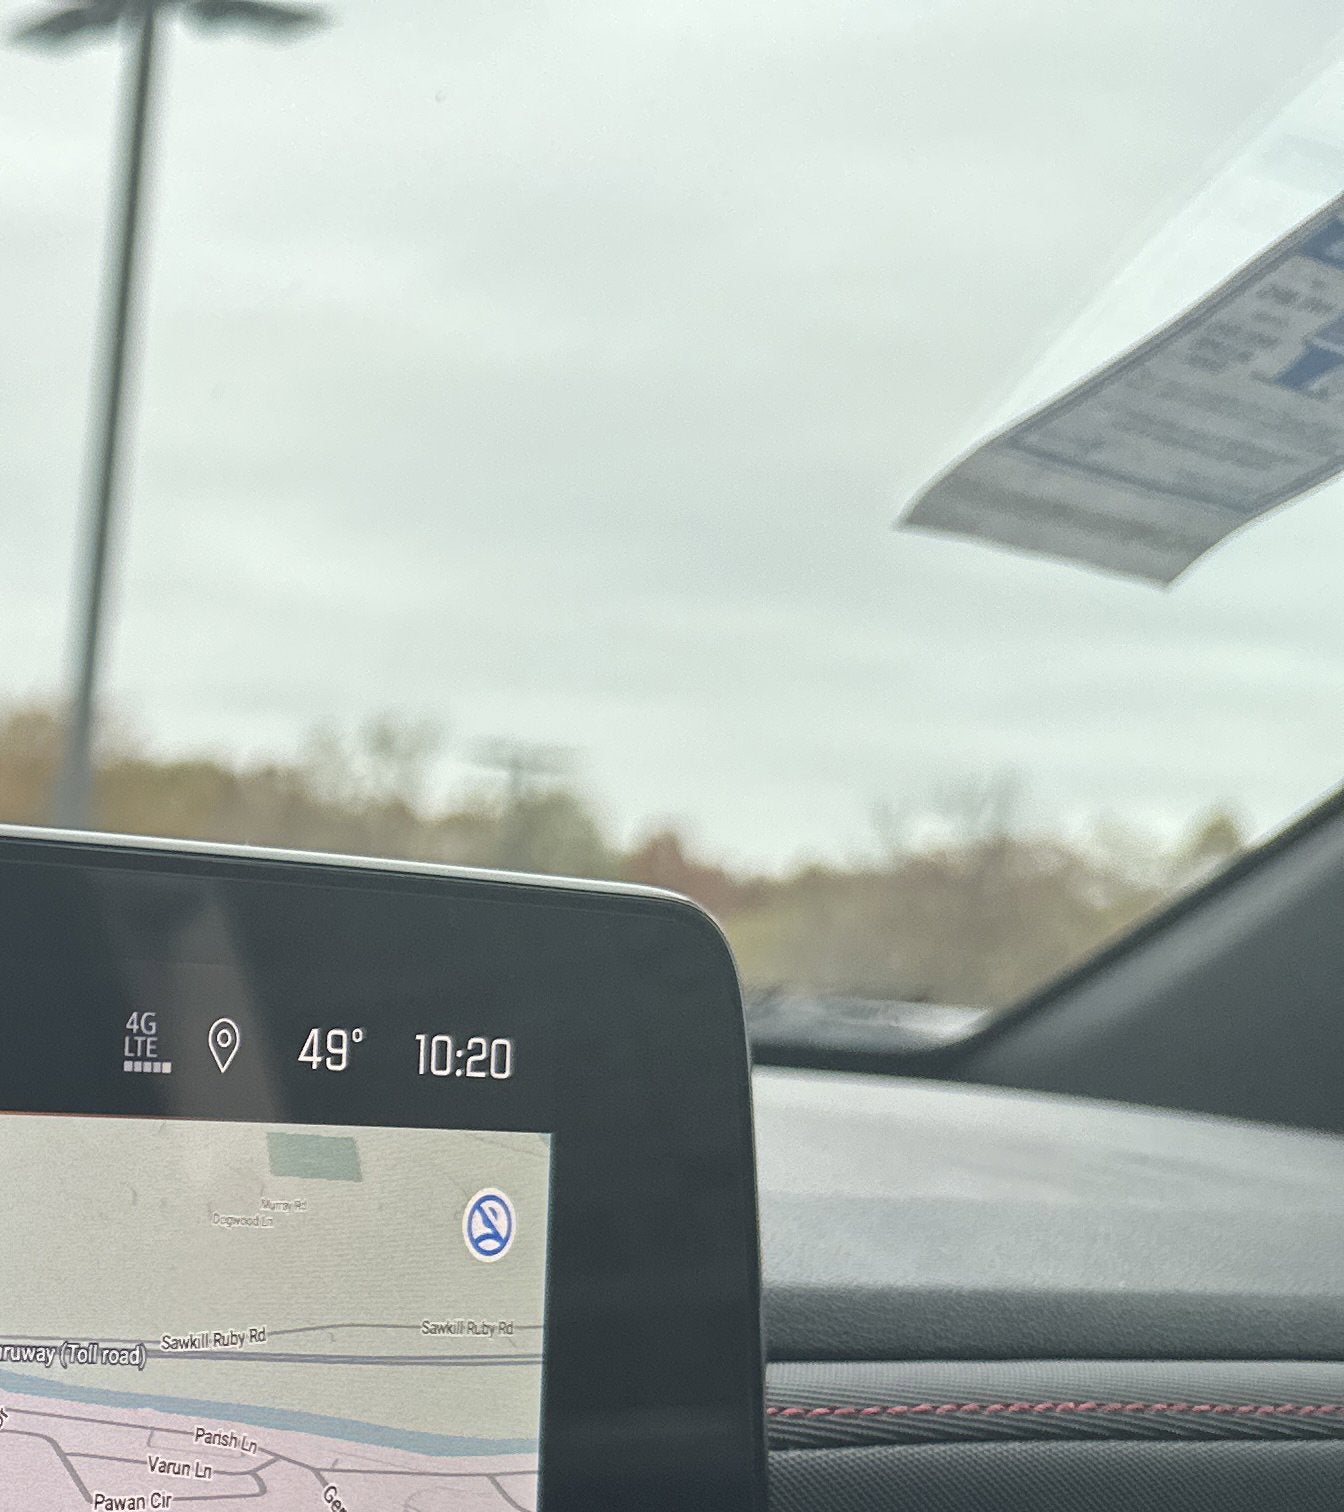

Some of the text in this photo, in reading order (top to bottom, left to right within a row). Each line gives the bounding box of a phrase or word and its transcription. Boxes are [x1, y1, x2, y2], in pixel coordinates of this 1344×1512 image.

[125, 1011, 157, 1035] 4G
[123, 1035, 158, 1059] LTE
[297, 1028, 365, 1072] 49°
[415, 1033, 513, 1079] 10:20
[161, 1327, 266, 1350] Sawkill Ruby Rd
[422, 1321, 513, 1338] Sawkill Ruby Rd
[59, 1342, 97, 1369] (Toll
[100, 1344, 147, 1370] road)
[194, 1428, 257, 1453] Parish Ln
[147, 1456, 212, 1478] Varun Ln
[93, 1492, 172, 1511] Pawan Cir
